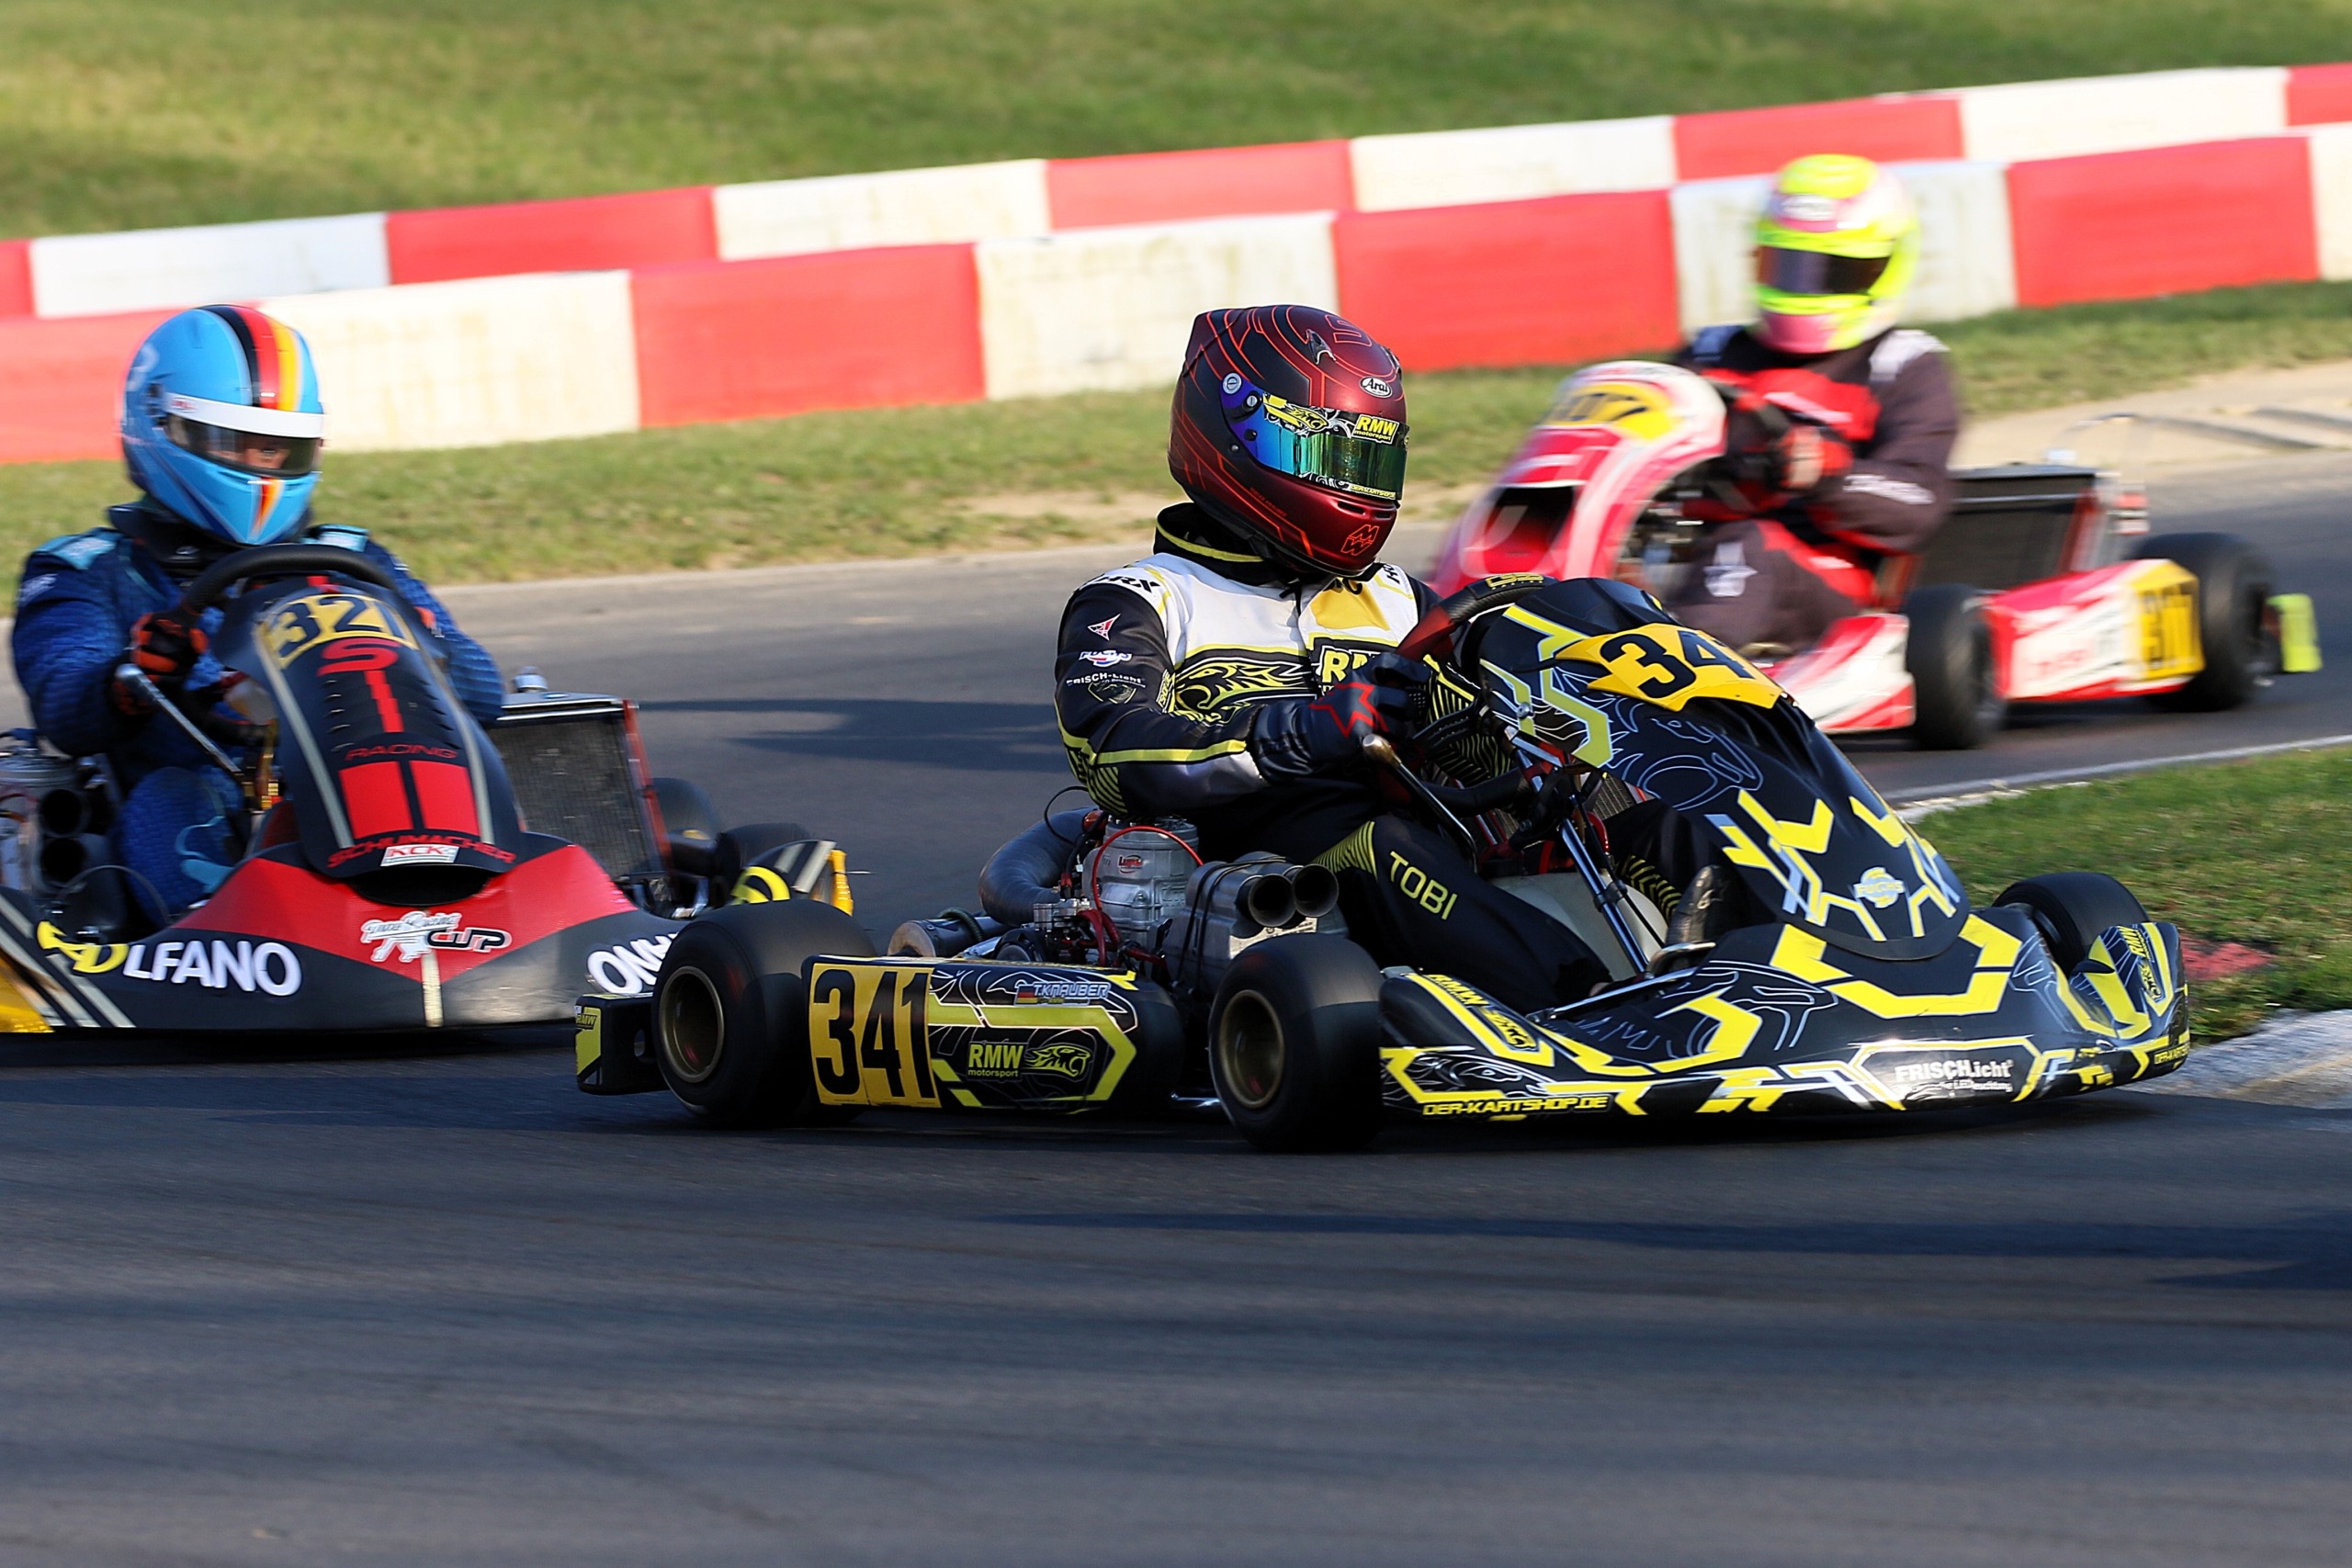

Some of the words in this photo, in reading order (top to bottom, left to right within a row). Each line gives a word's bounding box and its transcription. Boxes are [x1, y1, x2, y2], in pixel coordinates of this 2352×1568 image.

[1363, 378, 1388, 392] Arai
[1354, 430, 1391, 441] motorsport
[1357, 416, 1397, 436] RMW
[1600, 630, 1756, 699] 34
[345, 744, 458, 761] RACING
[326, 834, 516, 868] SCHUMACHER
[1389, 851, 1458, 920] TOBI
[1424, 974, 1490, 1006] RMW
[813, 969, 936, 1099] 341
[967, 1044, 1024, 1069] RMW
[967, 1069, 1019, 1077] motorsport
